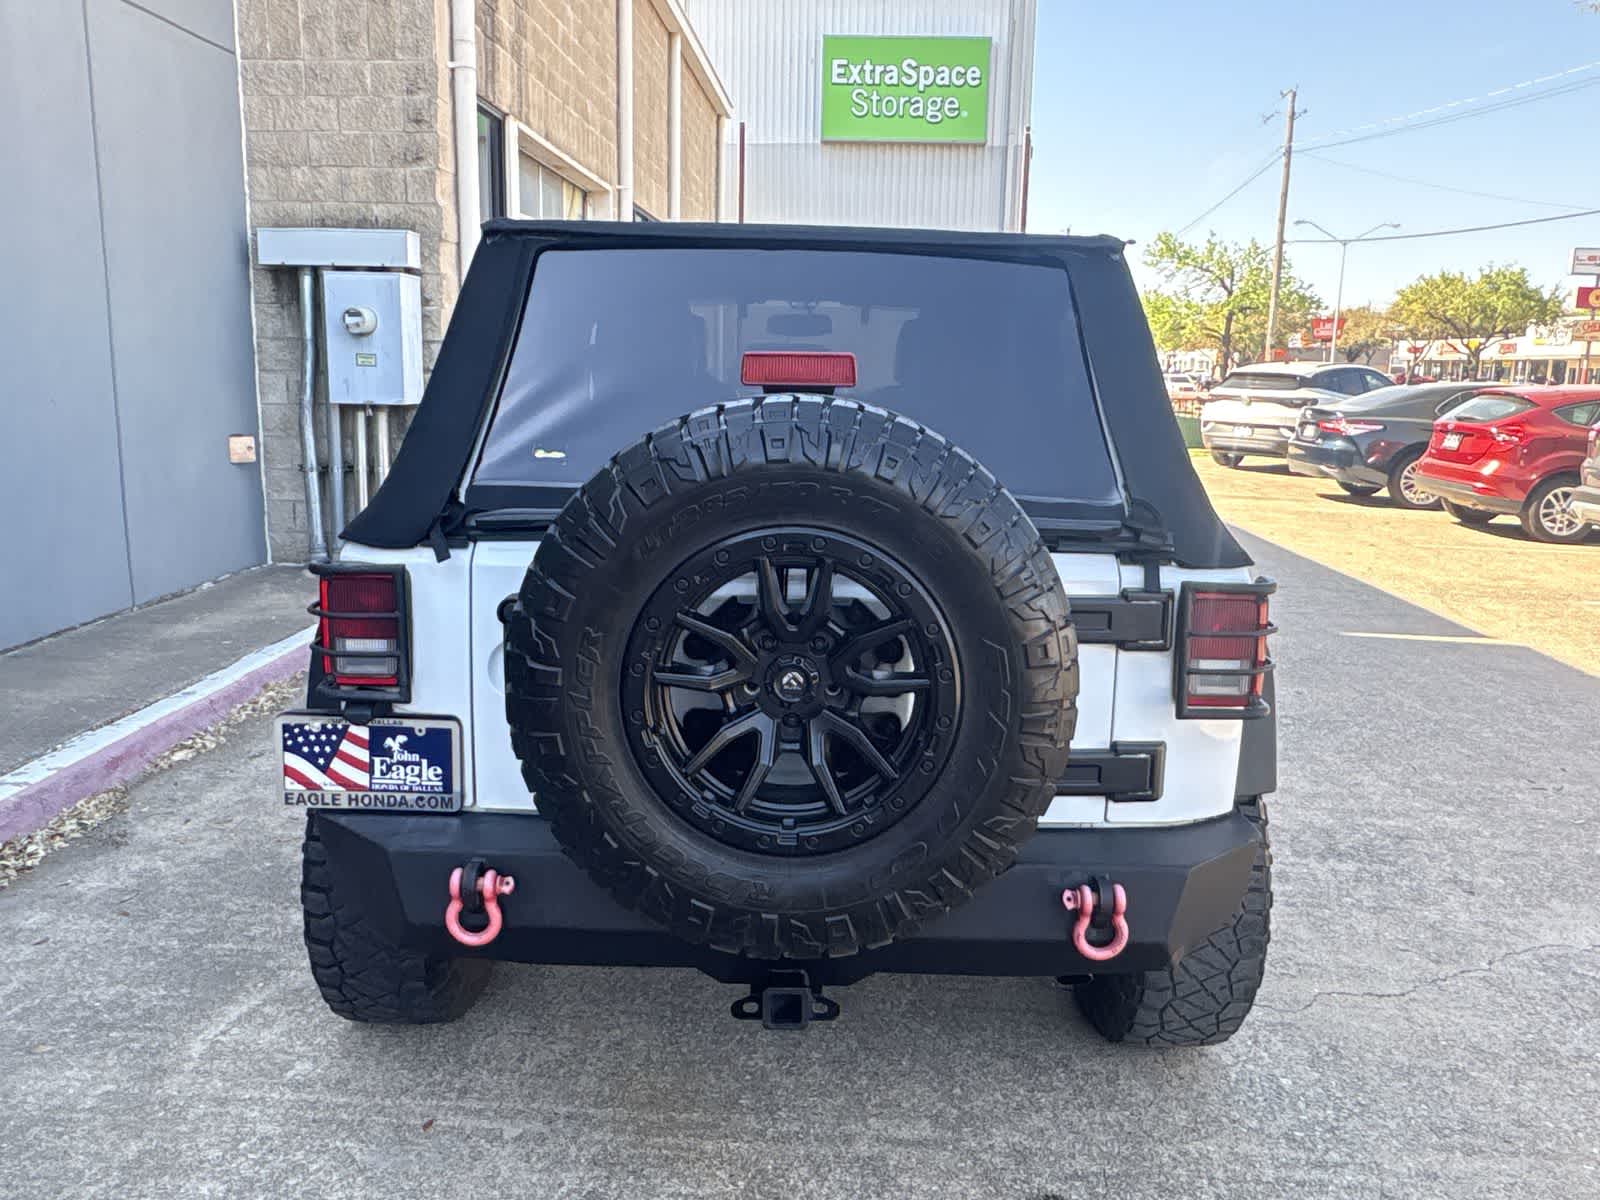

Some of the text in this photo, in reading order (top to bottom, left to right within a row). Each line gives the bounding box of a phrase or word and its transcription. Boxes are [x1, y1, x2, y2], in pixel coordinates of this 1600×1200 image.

[391, 750, 420, 763] John
[371, 757, 443, 785] Eagle
[371, 783, 399, 791] HONDA
[284, 792, 454, 809] EAGLE HONDA.COM
